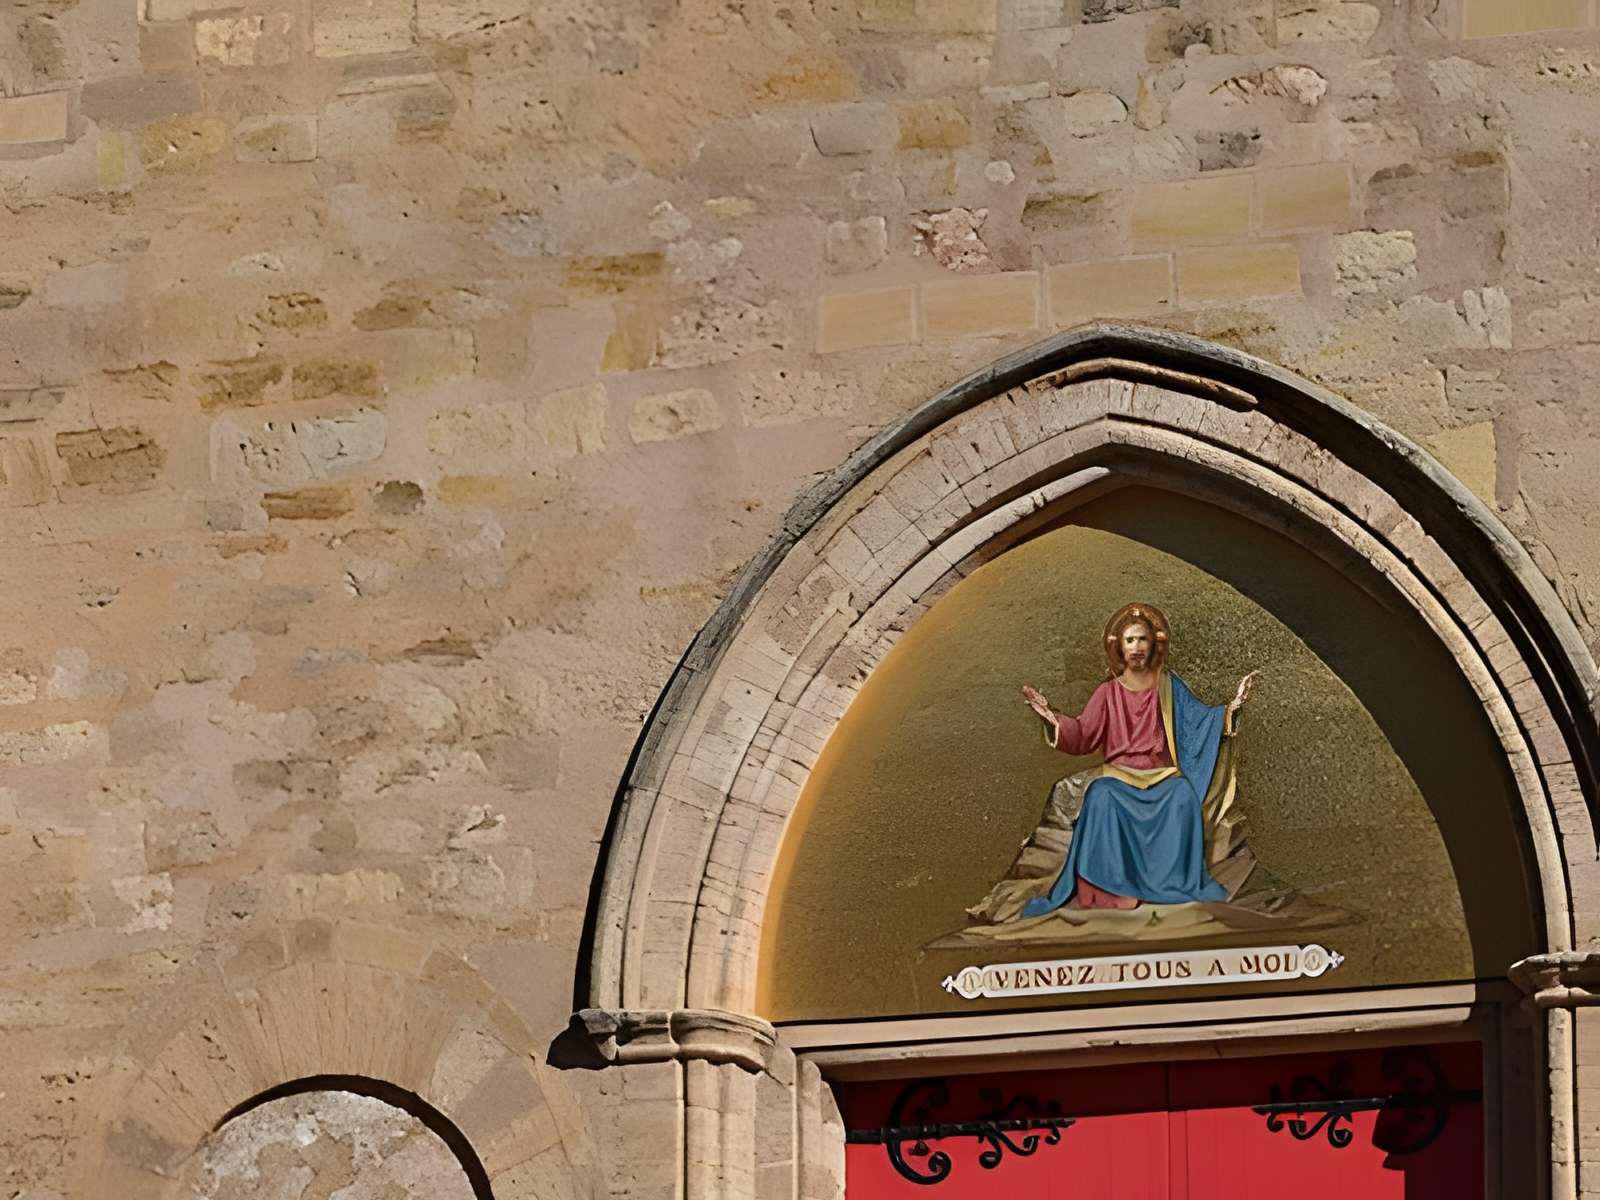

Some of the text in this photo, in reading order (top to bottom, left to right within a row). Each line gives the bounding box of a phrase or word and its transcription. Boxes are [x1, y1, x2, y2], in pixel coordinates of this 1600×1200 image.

[994, 953, 1290, 989] VENEZ TOUS A MOI
